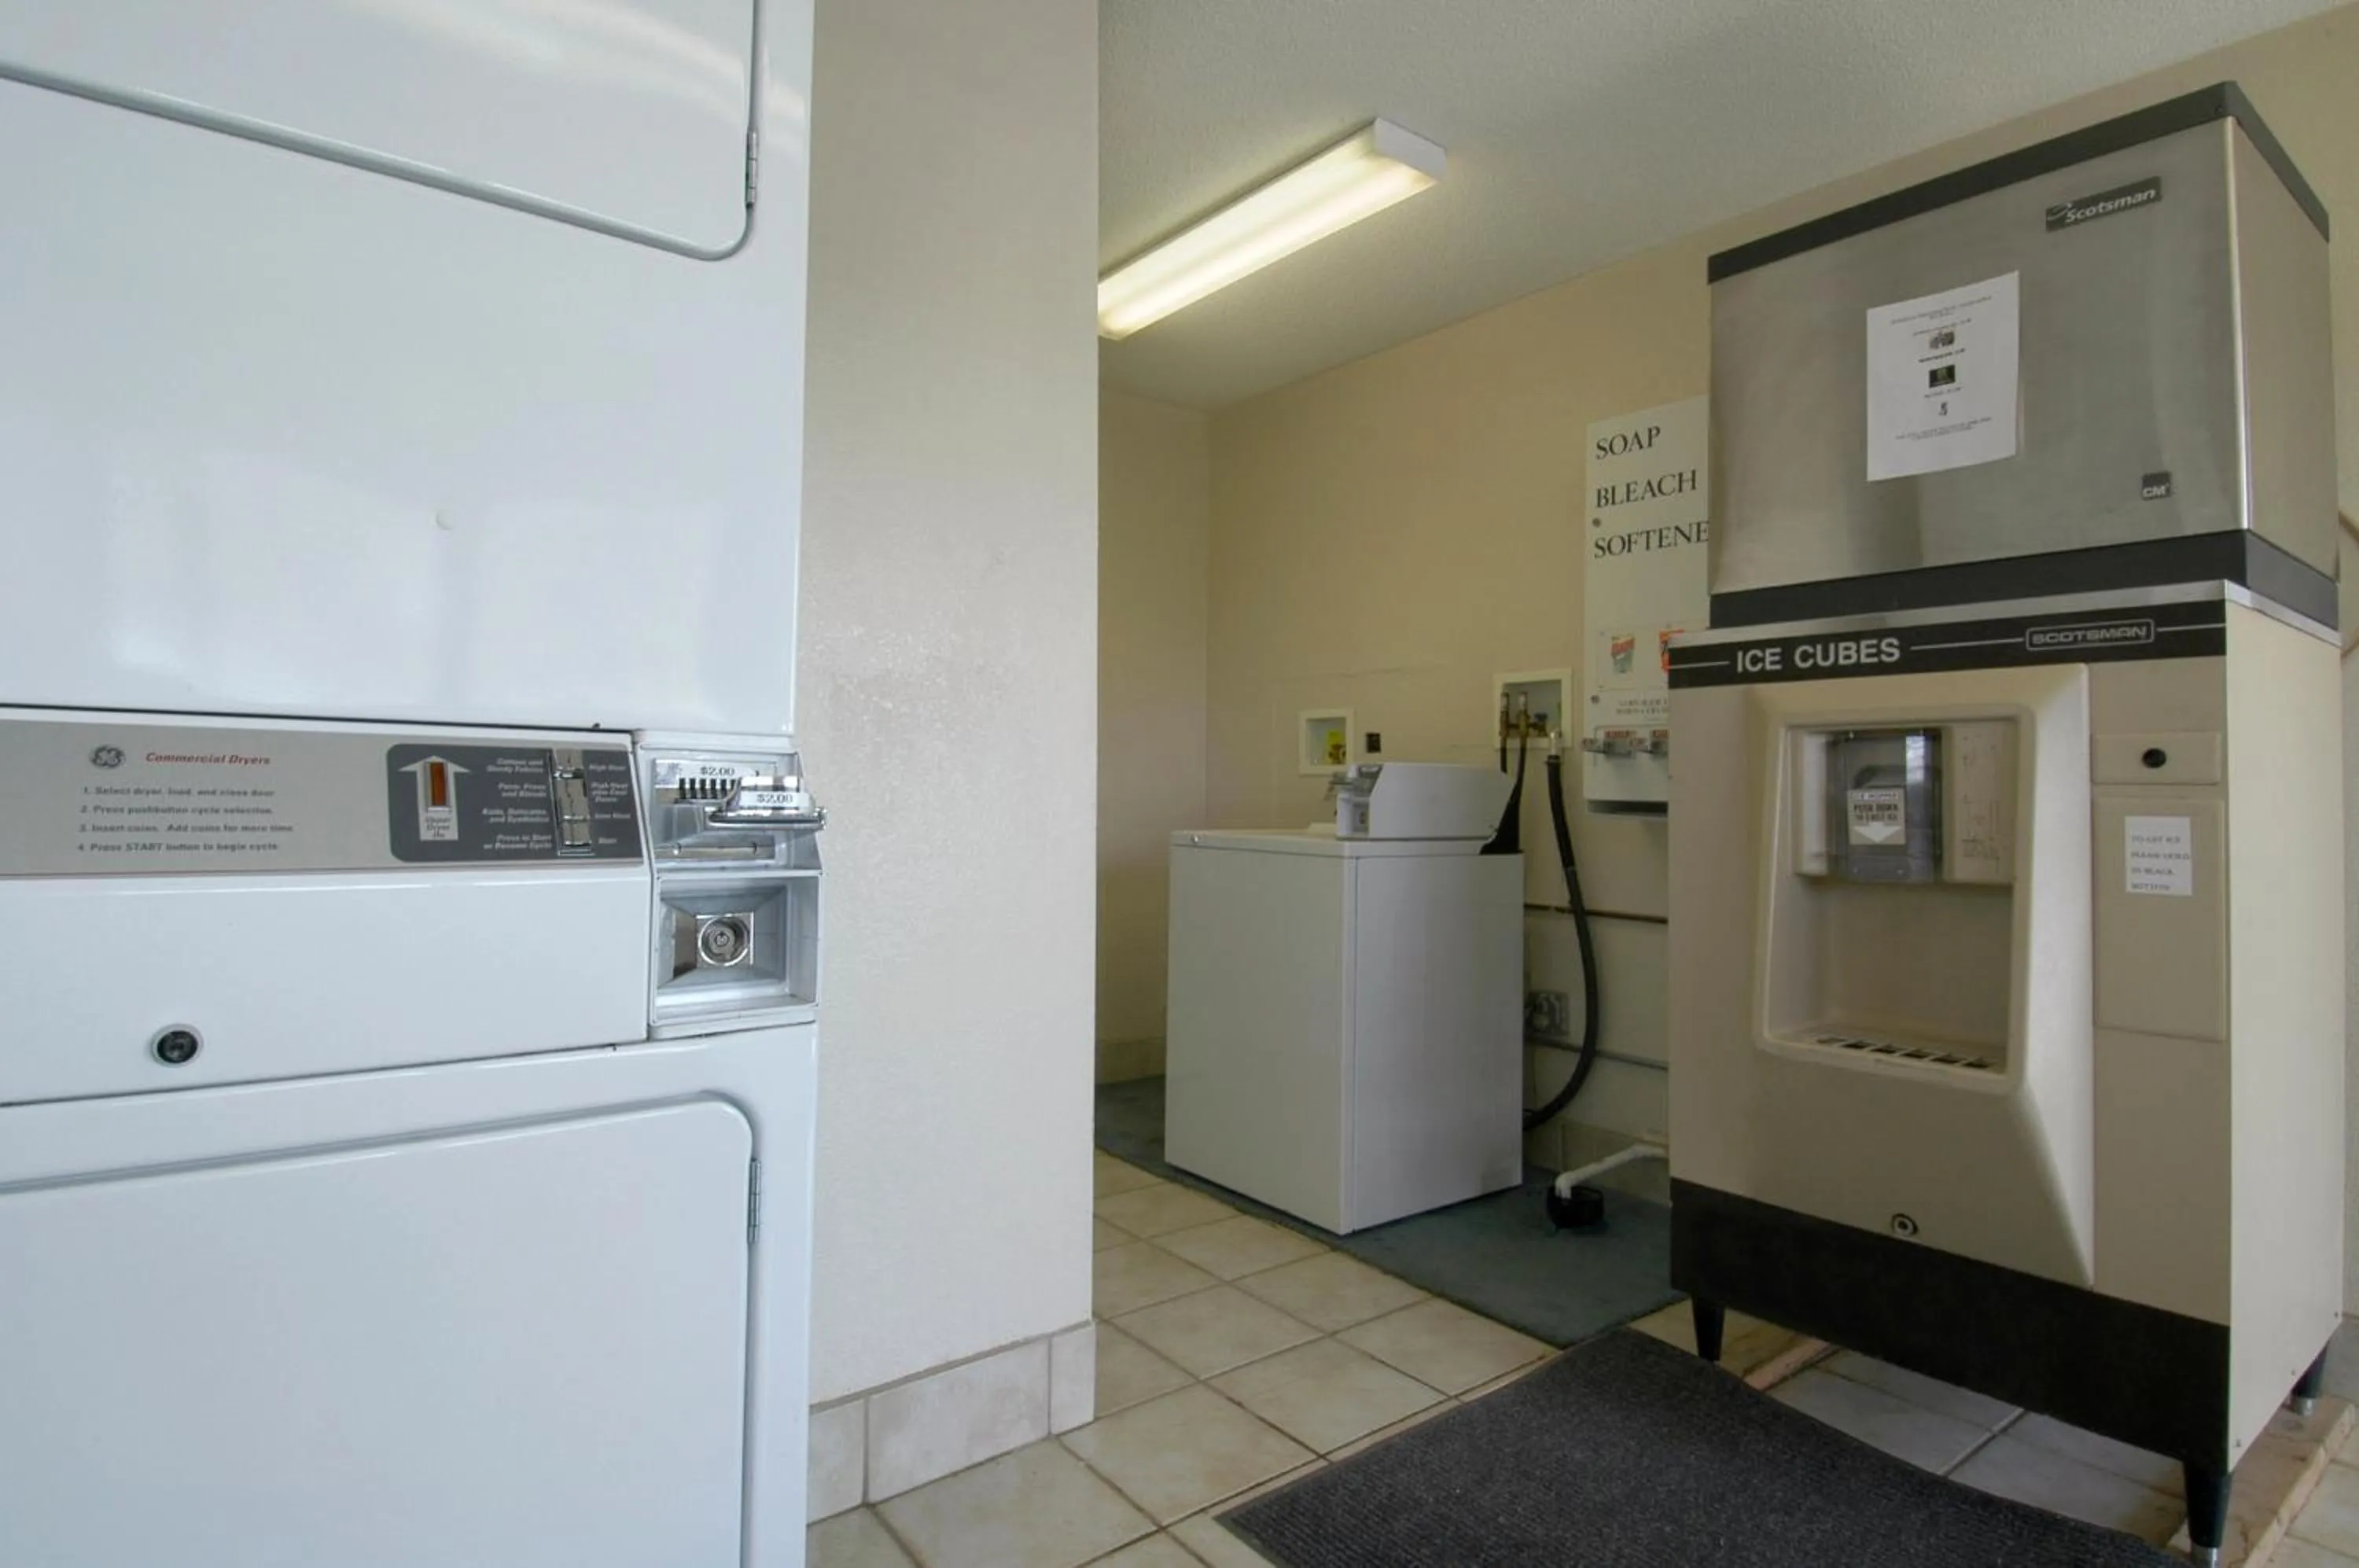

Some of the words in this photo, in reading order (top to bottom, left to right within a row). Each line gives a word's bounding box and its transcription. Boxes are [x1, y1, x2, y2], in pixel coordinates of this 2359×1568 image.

[1595, 425, 1662, 461] SOAP
[1596, 469, 1698, 508] BLEACH
[1594, 520, 1709, 559] SOFTENE
[2032, 626, 2147, 645] SCOTSMAN
[1737, 647, 1783, 673] ICE
[1794, 637, 1901, 669] CUBES
[145, 752, 226, 765] Commercial
[228, 754, 270, 766] Dryers
[700, 767, 735, 776] $2.00
[94, 786, 130, 795] Select
[756, 793, 793, 804] $2.00
[93, 805, 125, 815] Press
[90, 842, 122, 852] Press
[126, 842, 164, 852] START
